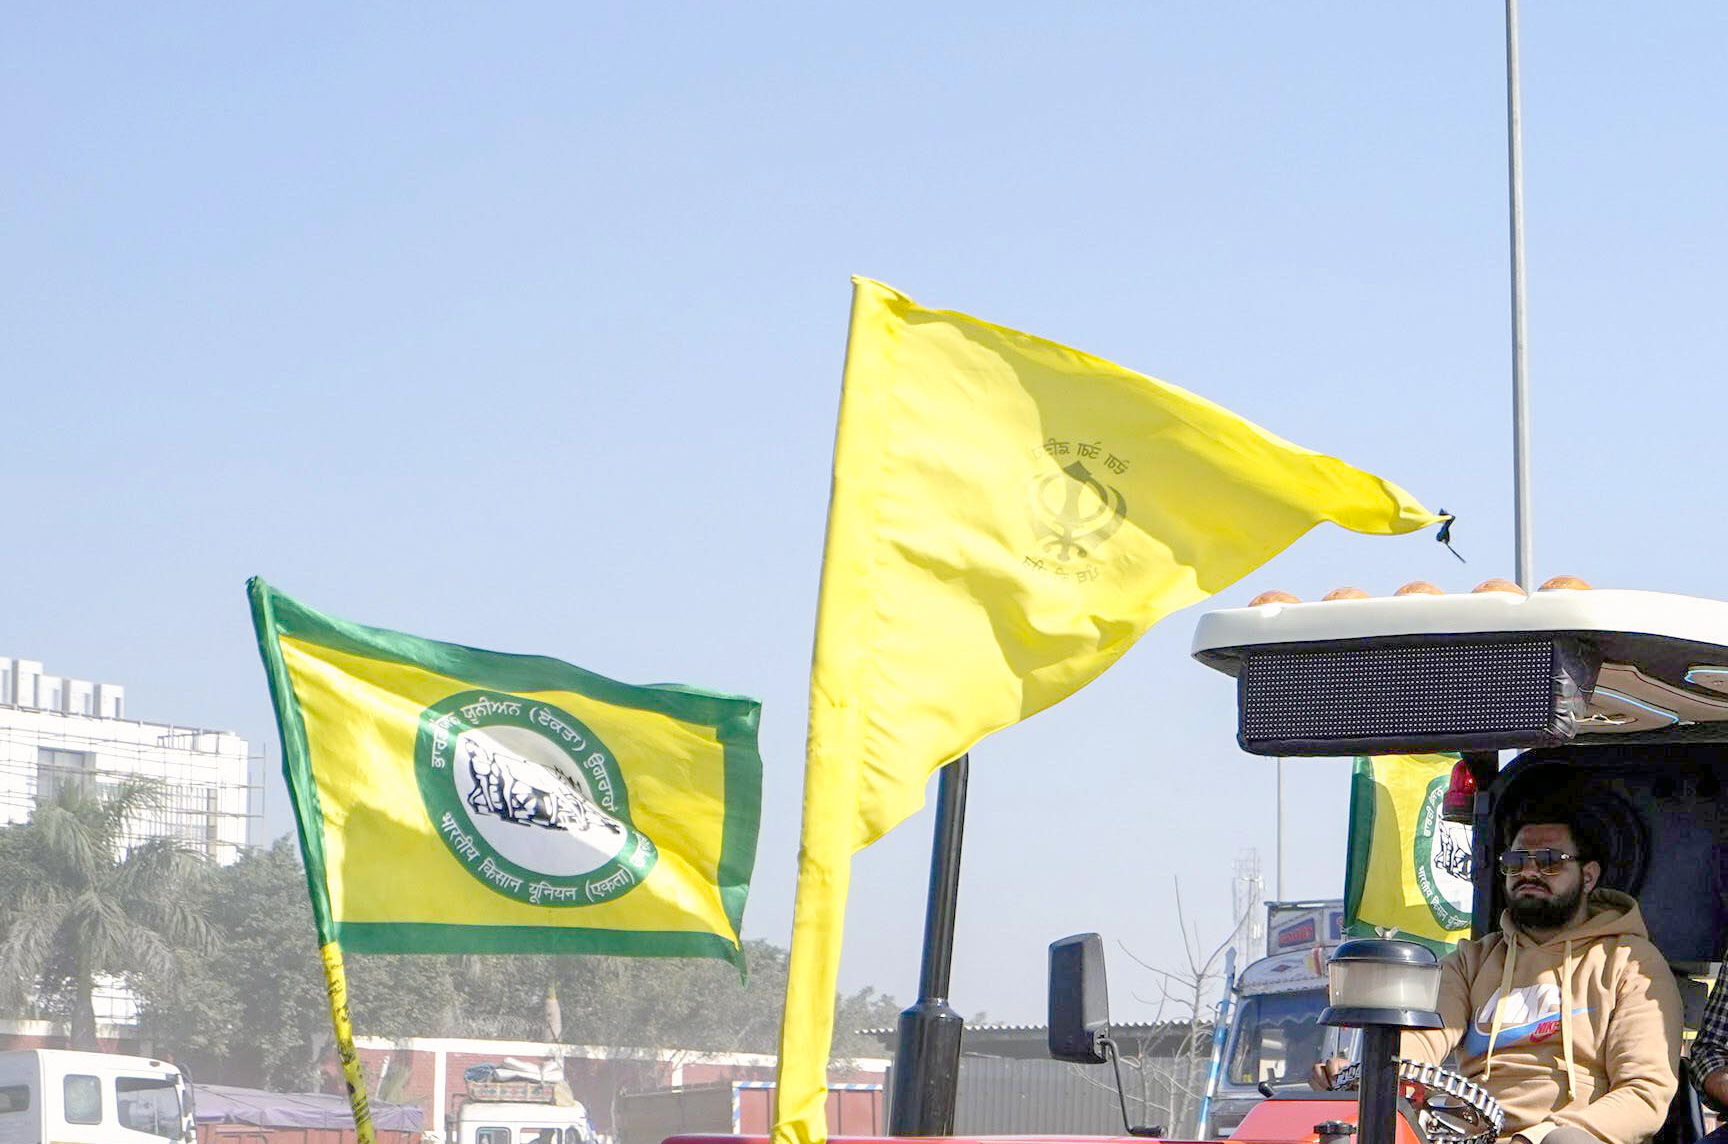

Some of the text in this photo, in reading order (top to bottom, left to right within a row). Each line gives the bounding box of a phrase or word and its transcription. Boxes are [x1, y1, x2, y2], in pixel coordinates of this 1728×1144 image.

[460, 696, 523, 725] ਯੂਨੀਅਨ
[441, 812, 482, 862] भारतीय
[478, 858, 525, 893] किसान
[528, 882, 578, 905] यूनियन
